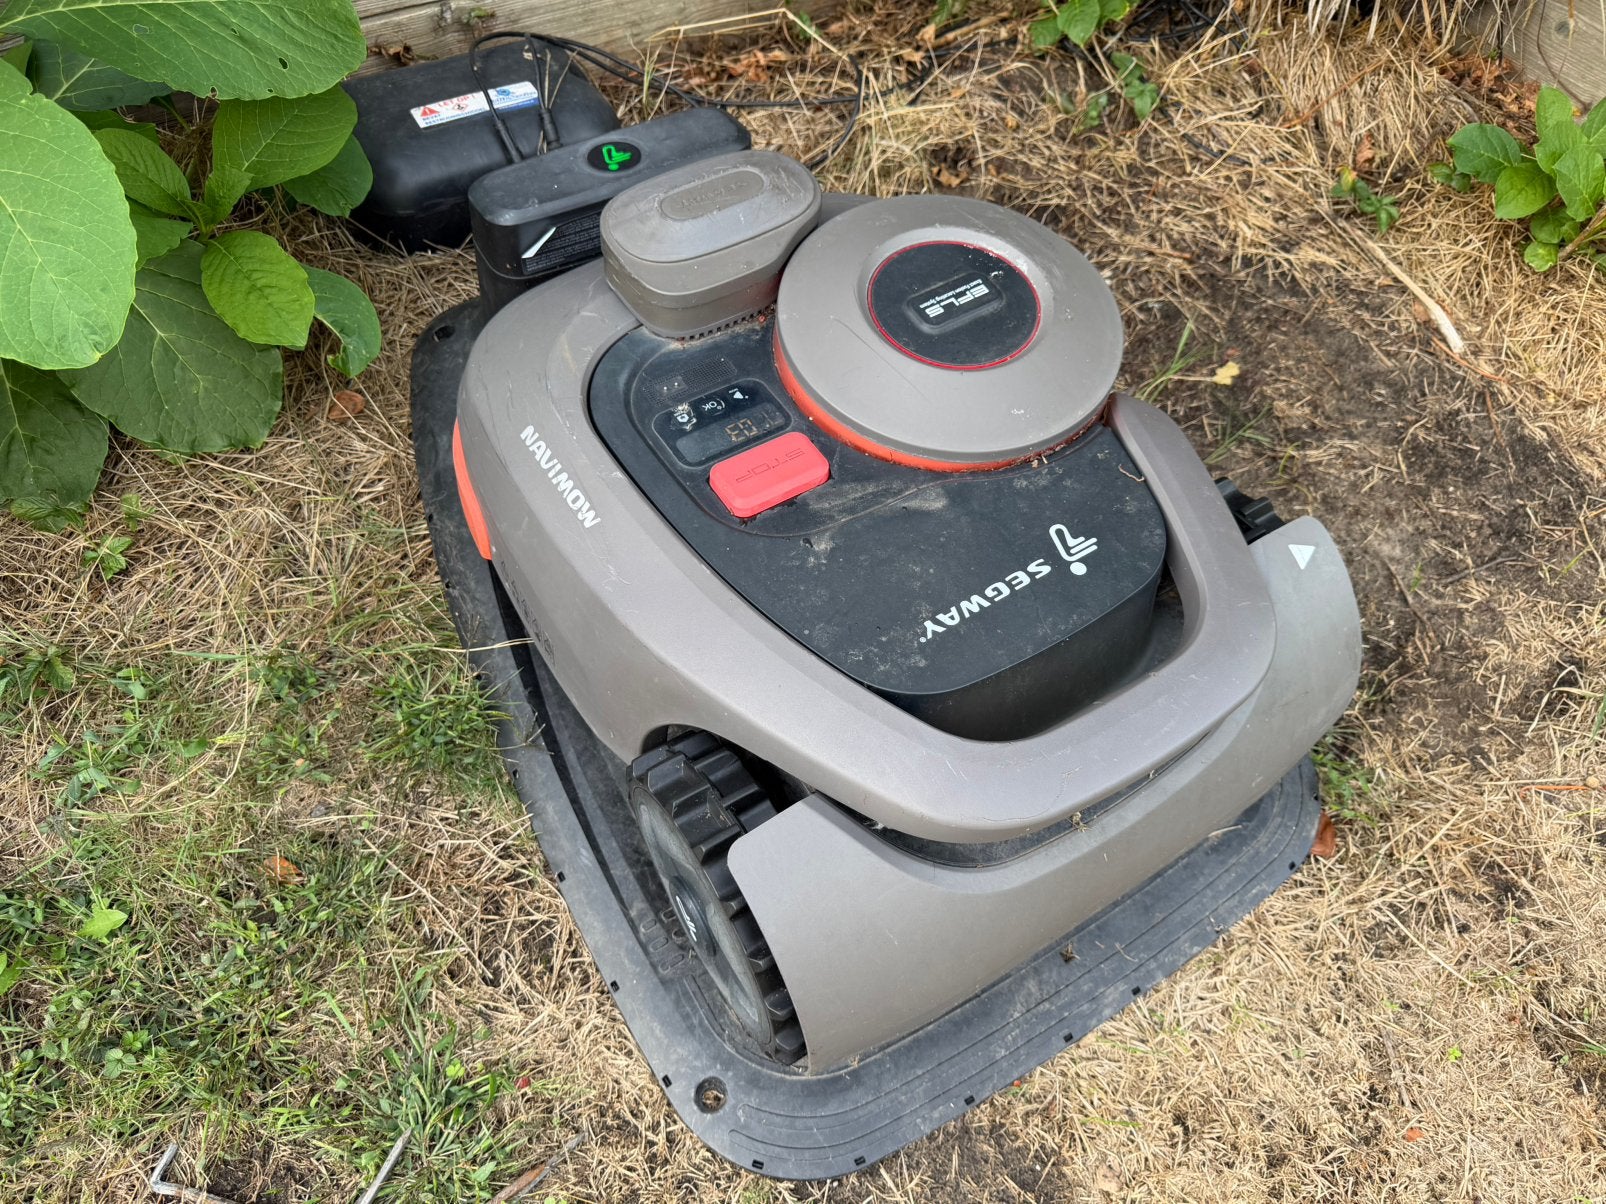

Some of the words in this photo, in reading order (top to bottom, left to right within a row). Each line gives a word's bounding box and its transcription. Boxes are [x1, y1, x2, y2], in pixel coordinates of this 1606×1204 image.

[919, 298, 937, 308] System
[925, 284, 989, 317] EFLS
[935, 290, 956, 301] Locating
[702, 400, 718, 411] OK
[736, 448, 805, 482] STOP
[520, 425, 601, 528] NAVIMOW
